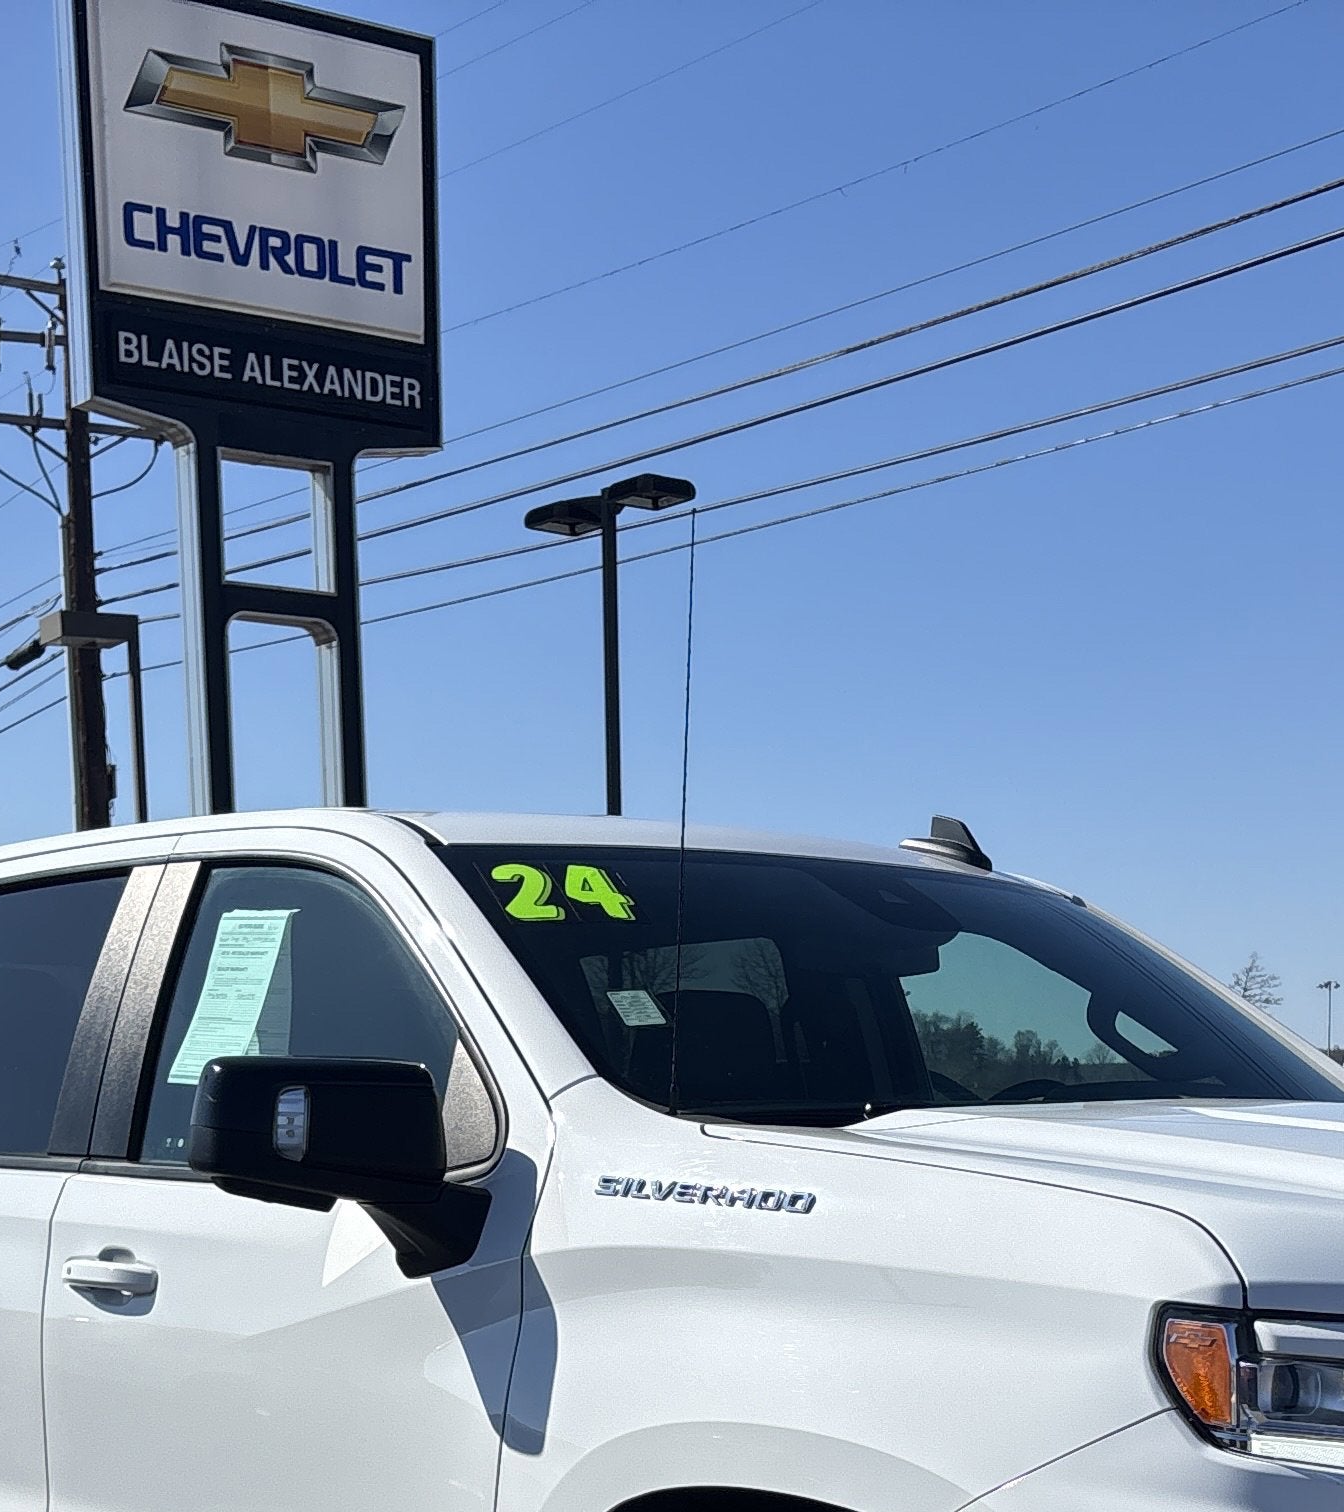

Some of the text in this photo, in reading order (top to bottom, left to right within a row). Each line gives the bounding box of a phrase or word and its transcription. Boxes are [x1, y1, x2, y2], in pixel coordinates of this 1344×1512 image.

[122, 200, 412, 295] CHEVROLET
[117, 330, 422, 410] BLAISE ALEXANDER
[491, 863, 636, 921] 24
[595, 1174, 817, 1215] SILVERADO
